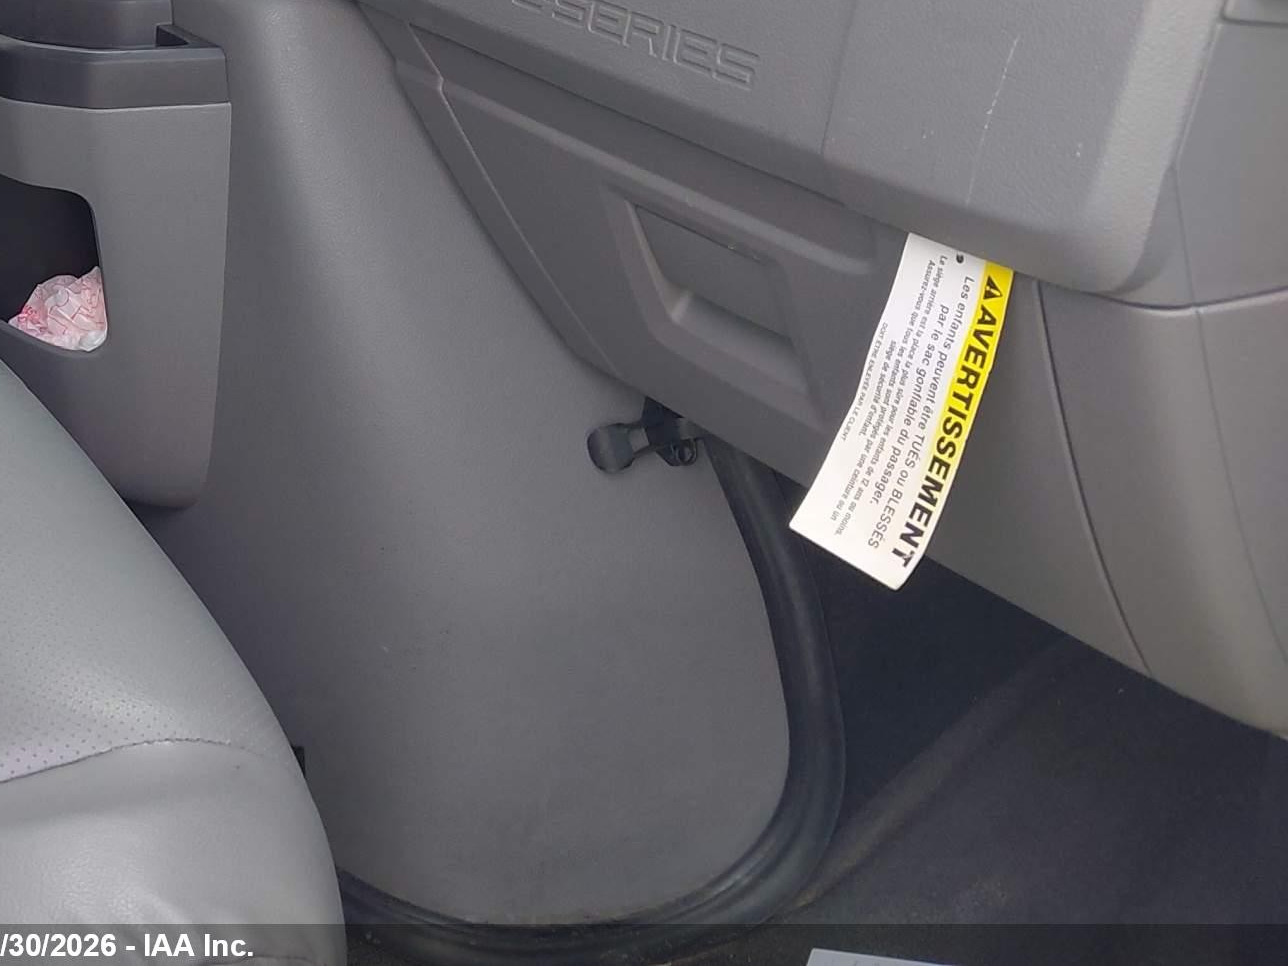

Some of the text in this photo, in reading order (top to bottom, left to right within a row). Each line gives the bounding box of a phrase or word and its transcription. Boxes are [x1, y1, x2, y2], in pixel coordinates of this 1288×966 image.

[961, 276, 975, 300] Les
[944, 302, 966, 350] enfants
[928, 350, 948, 404] peuvent
[870, 304, 950, 504] par le sac gonflable du passager.
[918, 404, 934, 430] être
[892, 304, 997, 568] AVERTISSEMENT
[896, 469, 909, 487] ou
[868, 487, 903, 548] BLESSÉS
